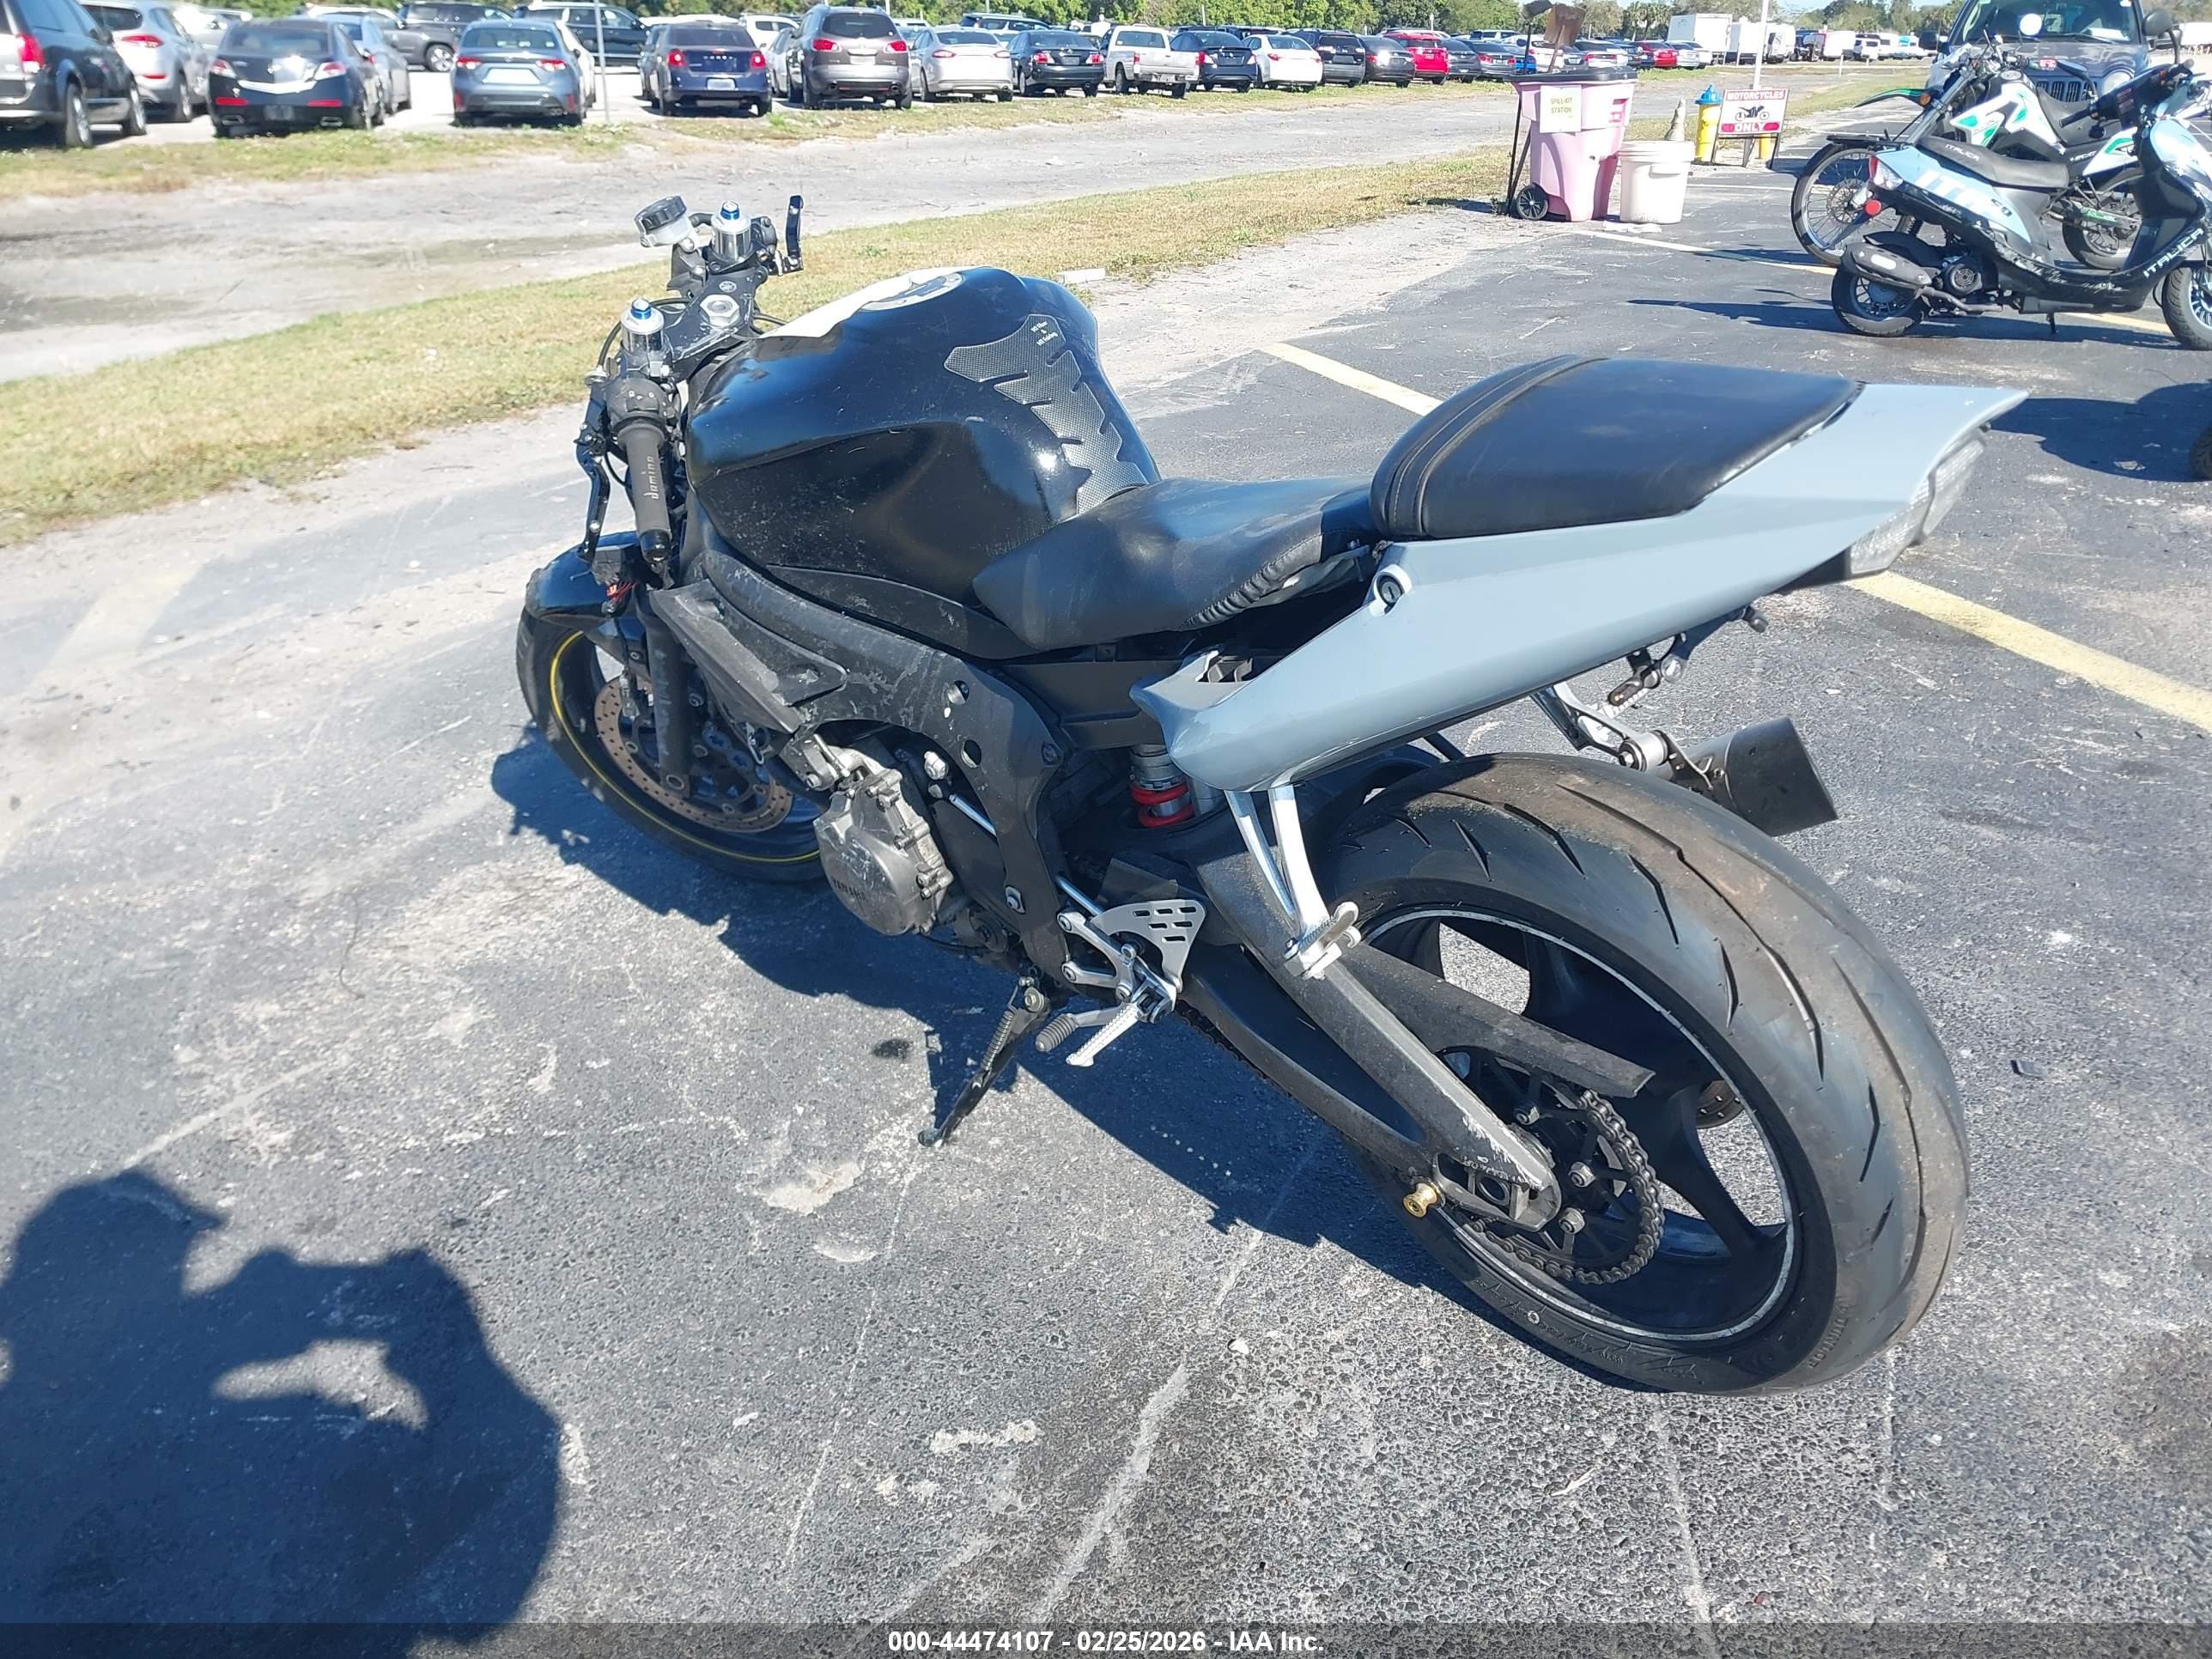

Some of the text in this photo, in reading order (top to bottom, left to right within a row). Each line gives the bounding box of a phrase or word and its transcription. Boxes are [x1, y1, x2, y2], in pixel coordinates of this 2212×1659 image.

[1727, 91, 1784, 100] MOTORCYCLES
[1735, 122, 1765, 132] ONLY
[1945, 143, 1980, 161] ITALICA
[2142, 227, 2204, 278] ITALICA
[641, 455, 660, 499] domino
